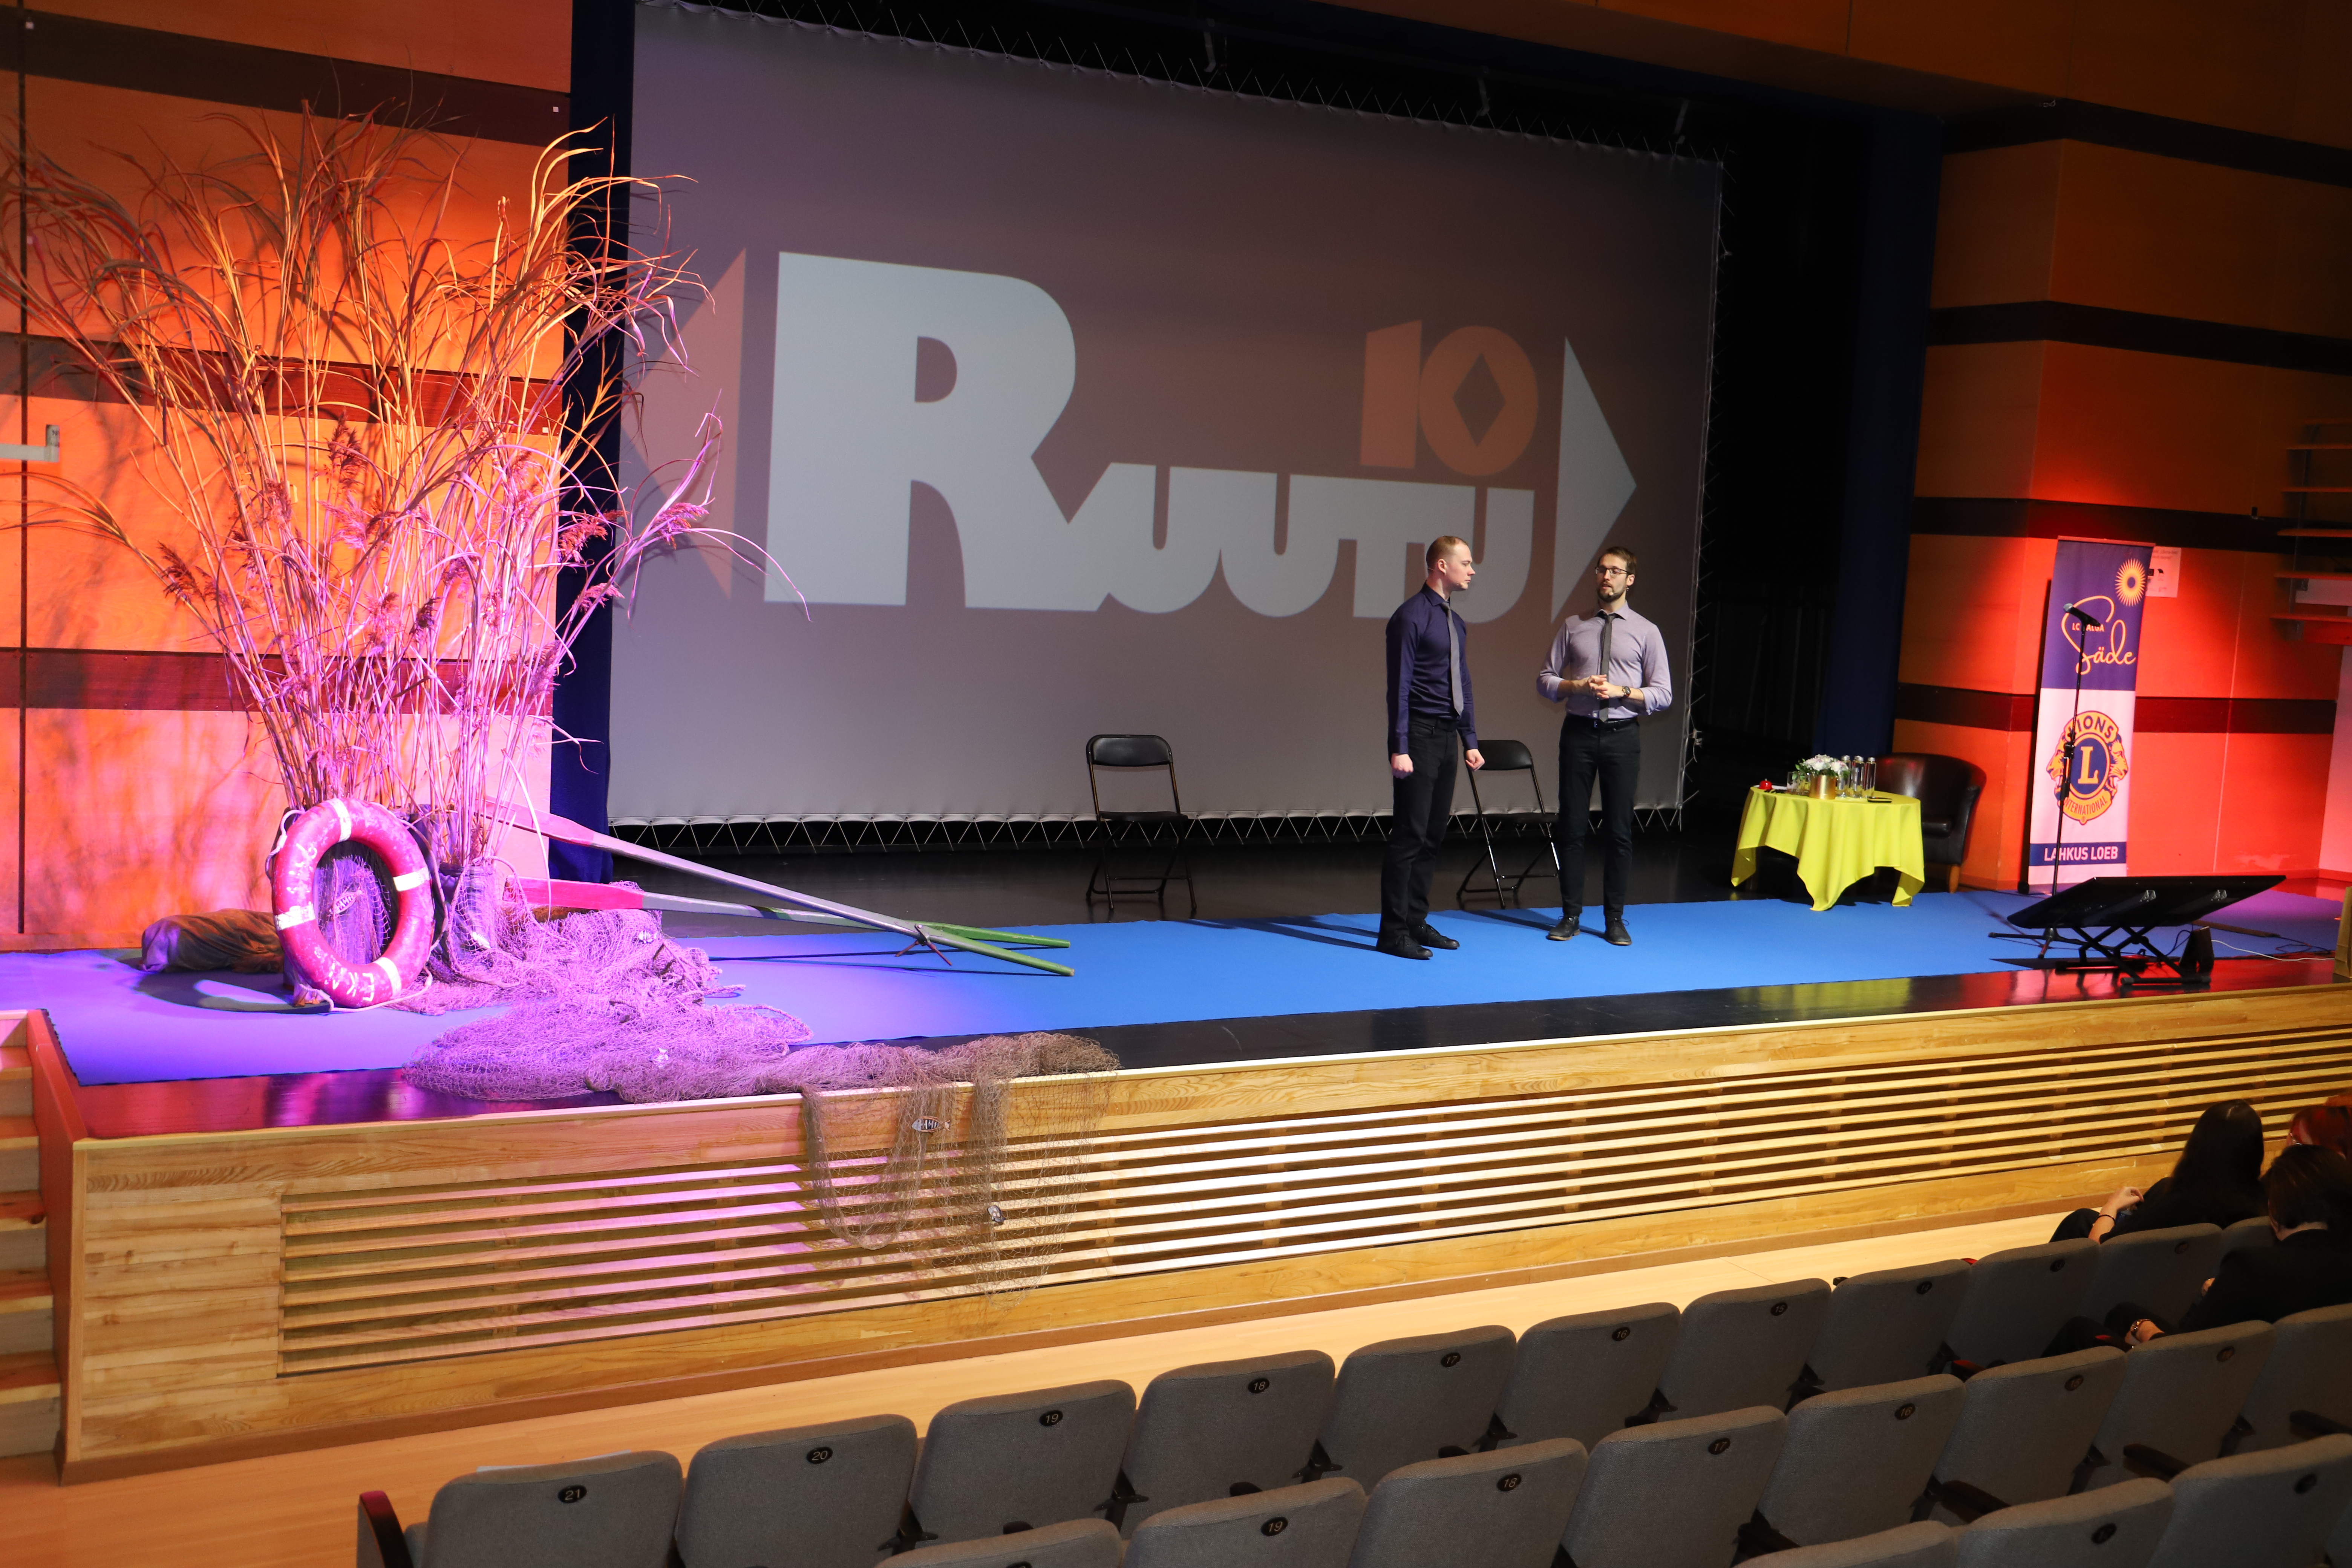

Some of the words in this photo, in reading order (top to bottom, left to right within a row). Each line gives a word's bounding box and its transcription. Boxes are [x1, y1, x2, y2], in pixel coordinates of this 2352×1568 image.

[1360, 320, 1538, 476] 10
[2072, 622, 2080, 631] LC
[2085, 624, 2105, 632] ALGA
[2061, 596, 2136, 675] Säde
[2078, 746, 2099, 784] L
[2064, 796, 2107, 815] NTERNATIONAL
[2044, 847, 2089, 861] LAHKUS
[2091, 846, 2119, 861] LOEB
[1775, 1305, 1785, 1314] 15
[1617, 1330, 1628, 1339] 16
[1447, 1355, 1458, 1364] 17
[1254, 1381, 1266, 1390] 18
[1900, 1407, 1911, 1416] 16
[1046, 1413, 1059, 1423] 19
[1714, 1441, 1727, 1452] 17
[812, 1450, 829, 1461] 20
[1503, 1477, 1517, 1488] 18
[564, 1488, 582, 1501] 21
[1269, 1521, 1283, 1532] 19
